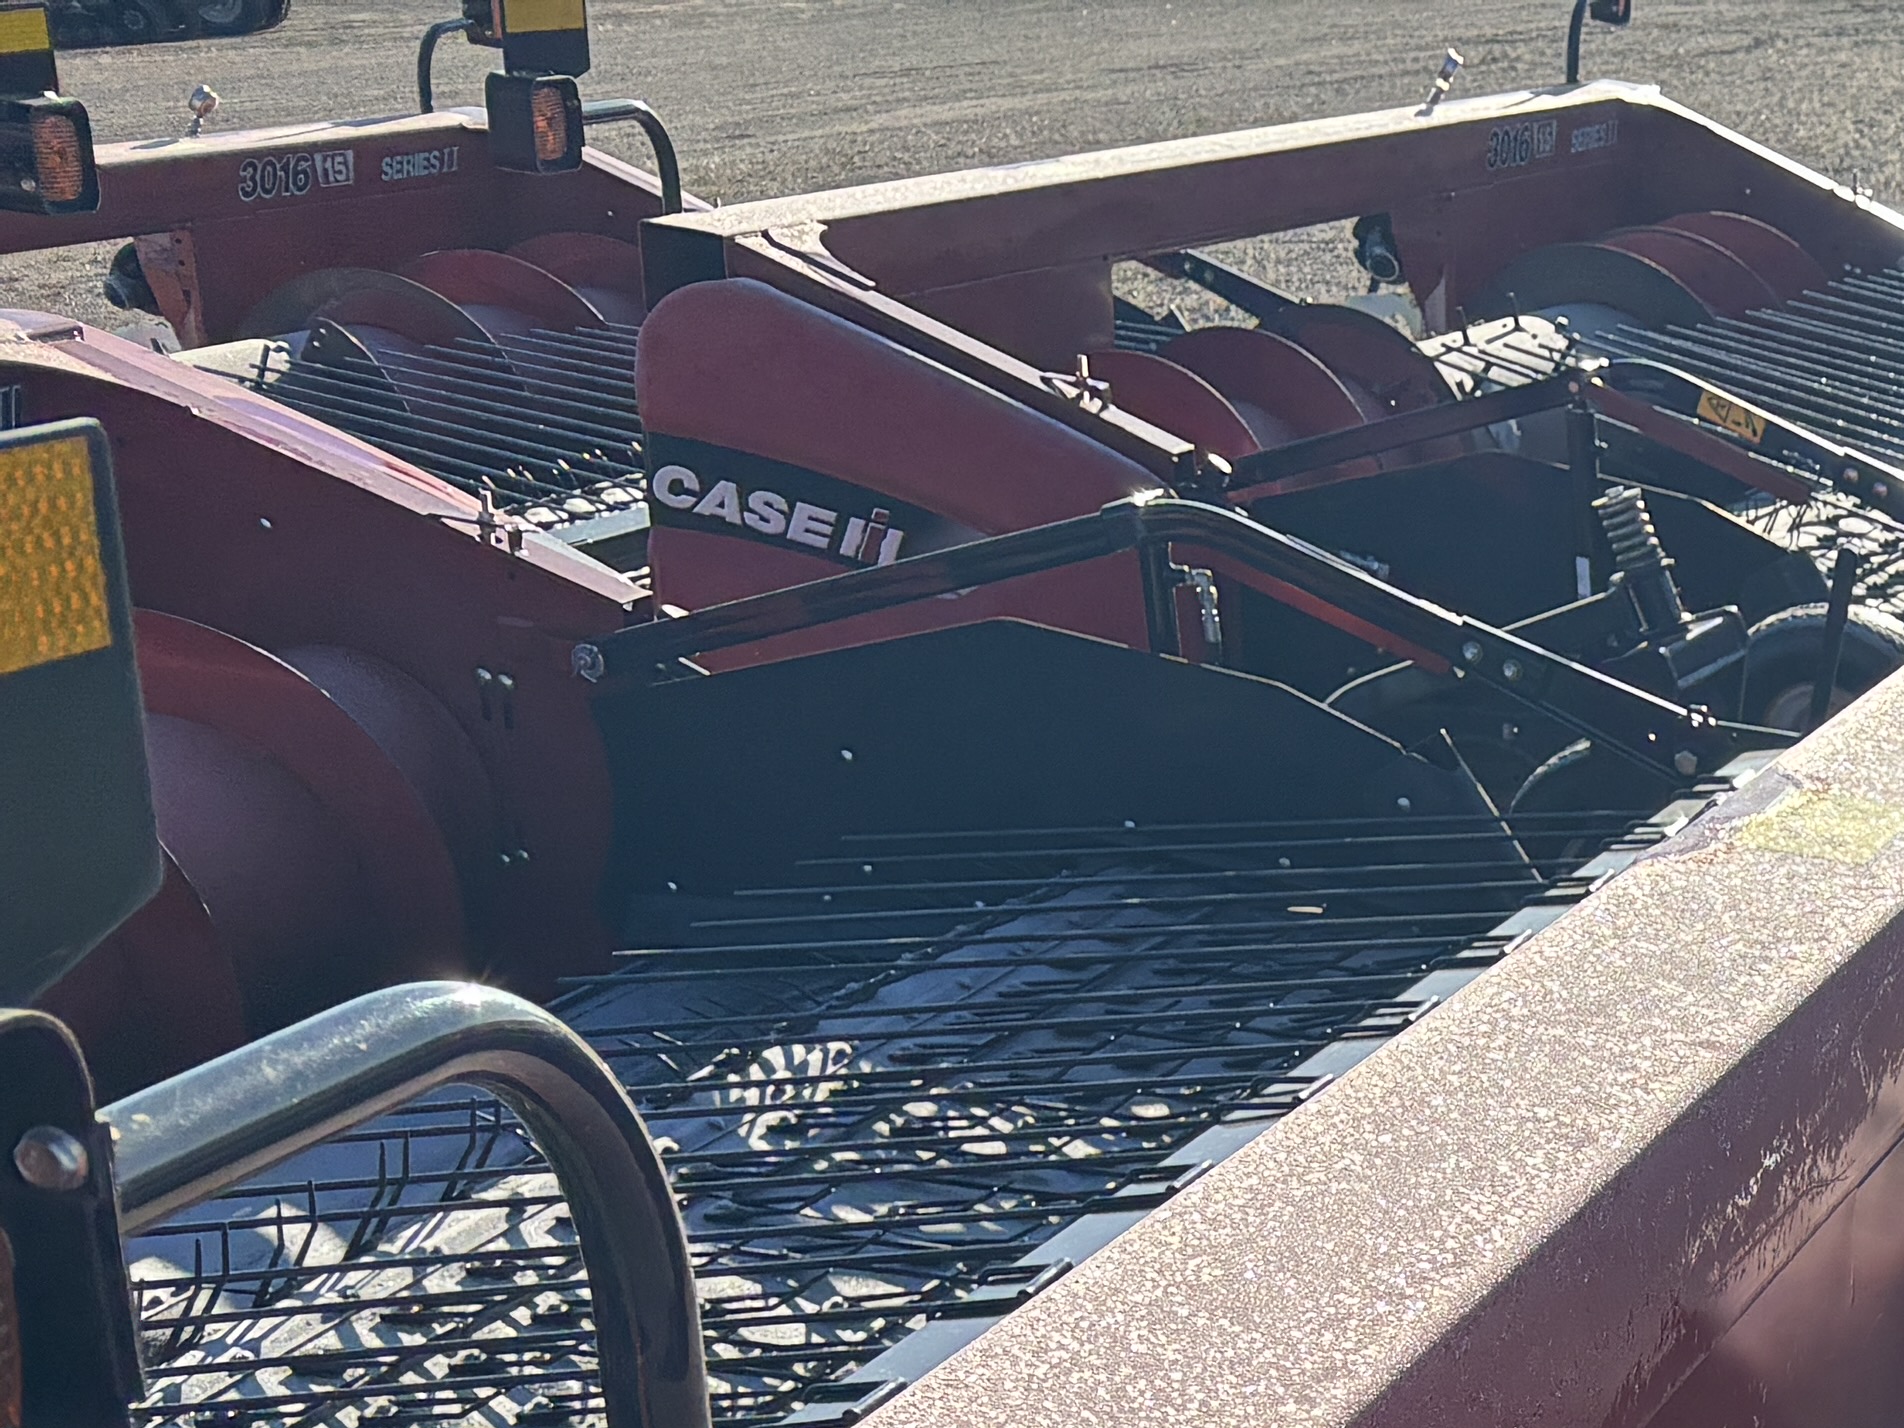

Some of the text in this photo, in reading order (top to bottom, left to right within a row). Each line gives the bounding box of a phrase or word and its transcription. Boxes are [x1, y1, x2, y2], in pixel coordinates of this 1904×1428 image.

[238, 153, 311, 201] 3016
[321, 152, 349, 184] 15
[381, 149, 440, 181] SERIES
[652, 465, 838, 549] CASE
